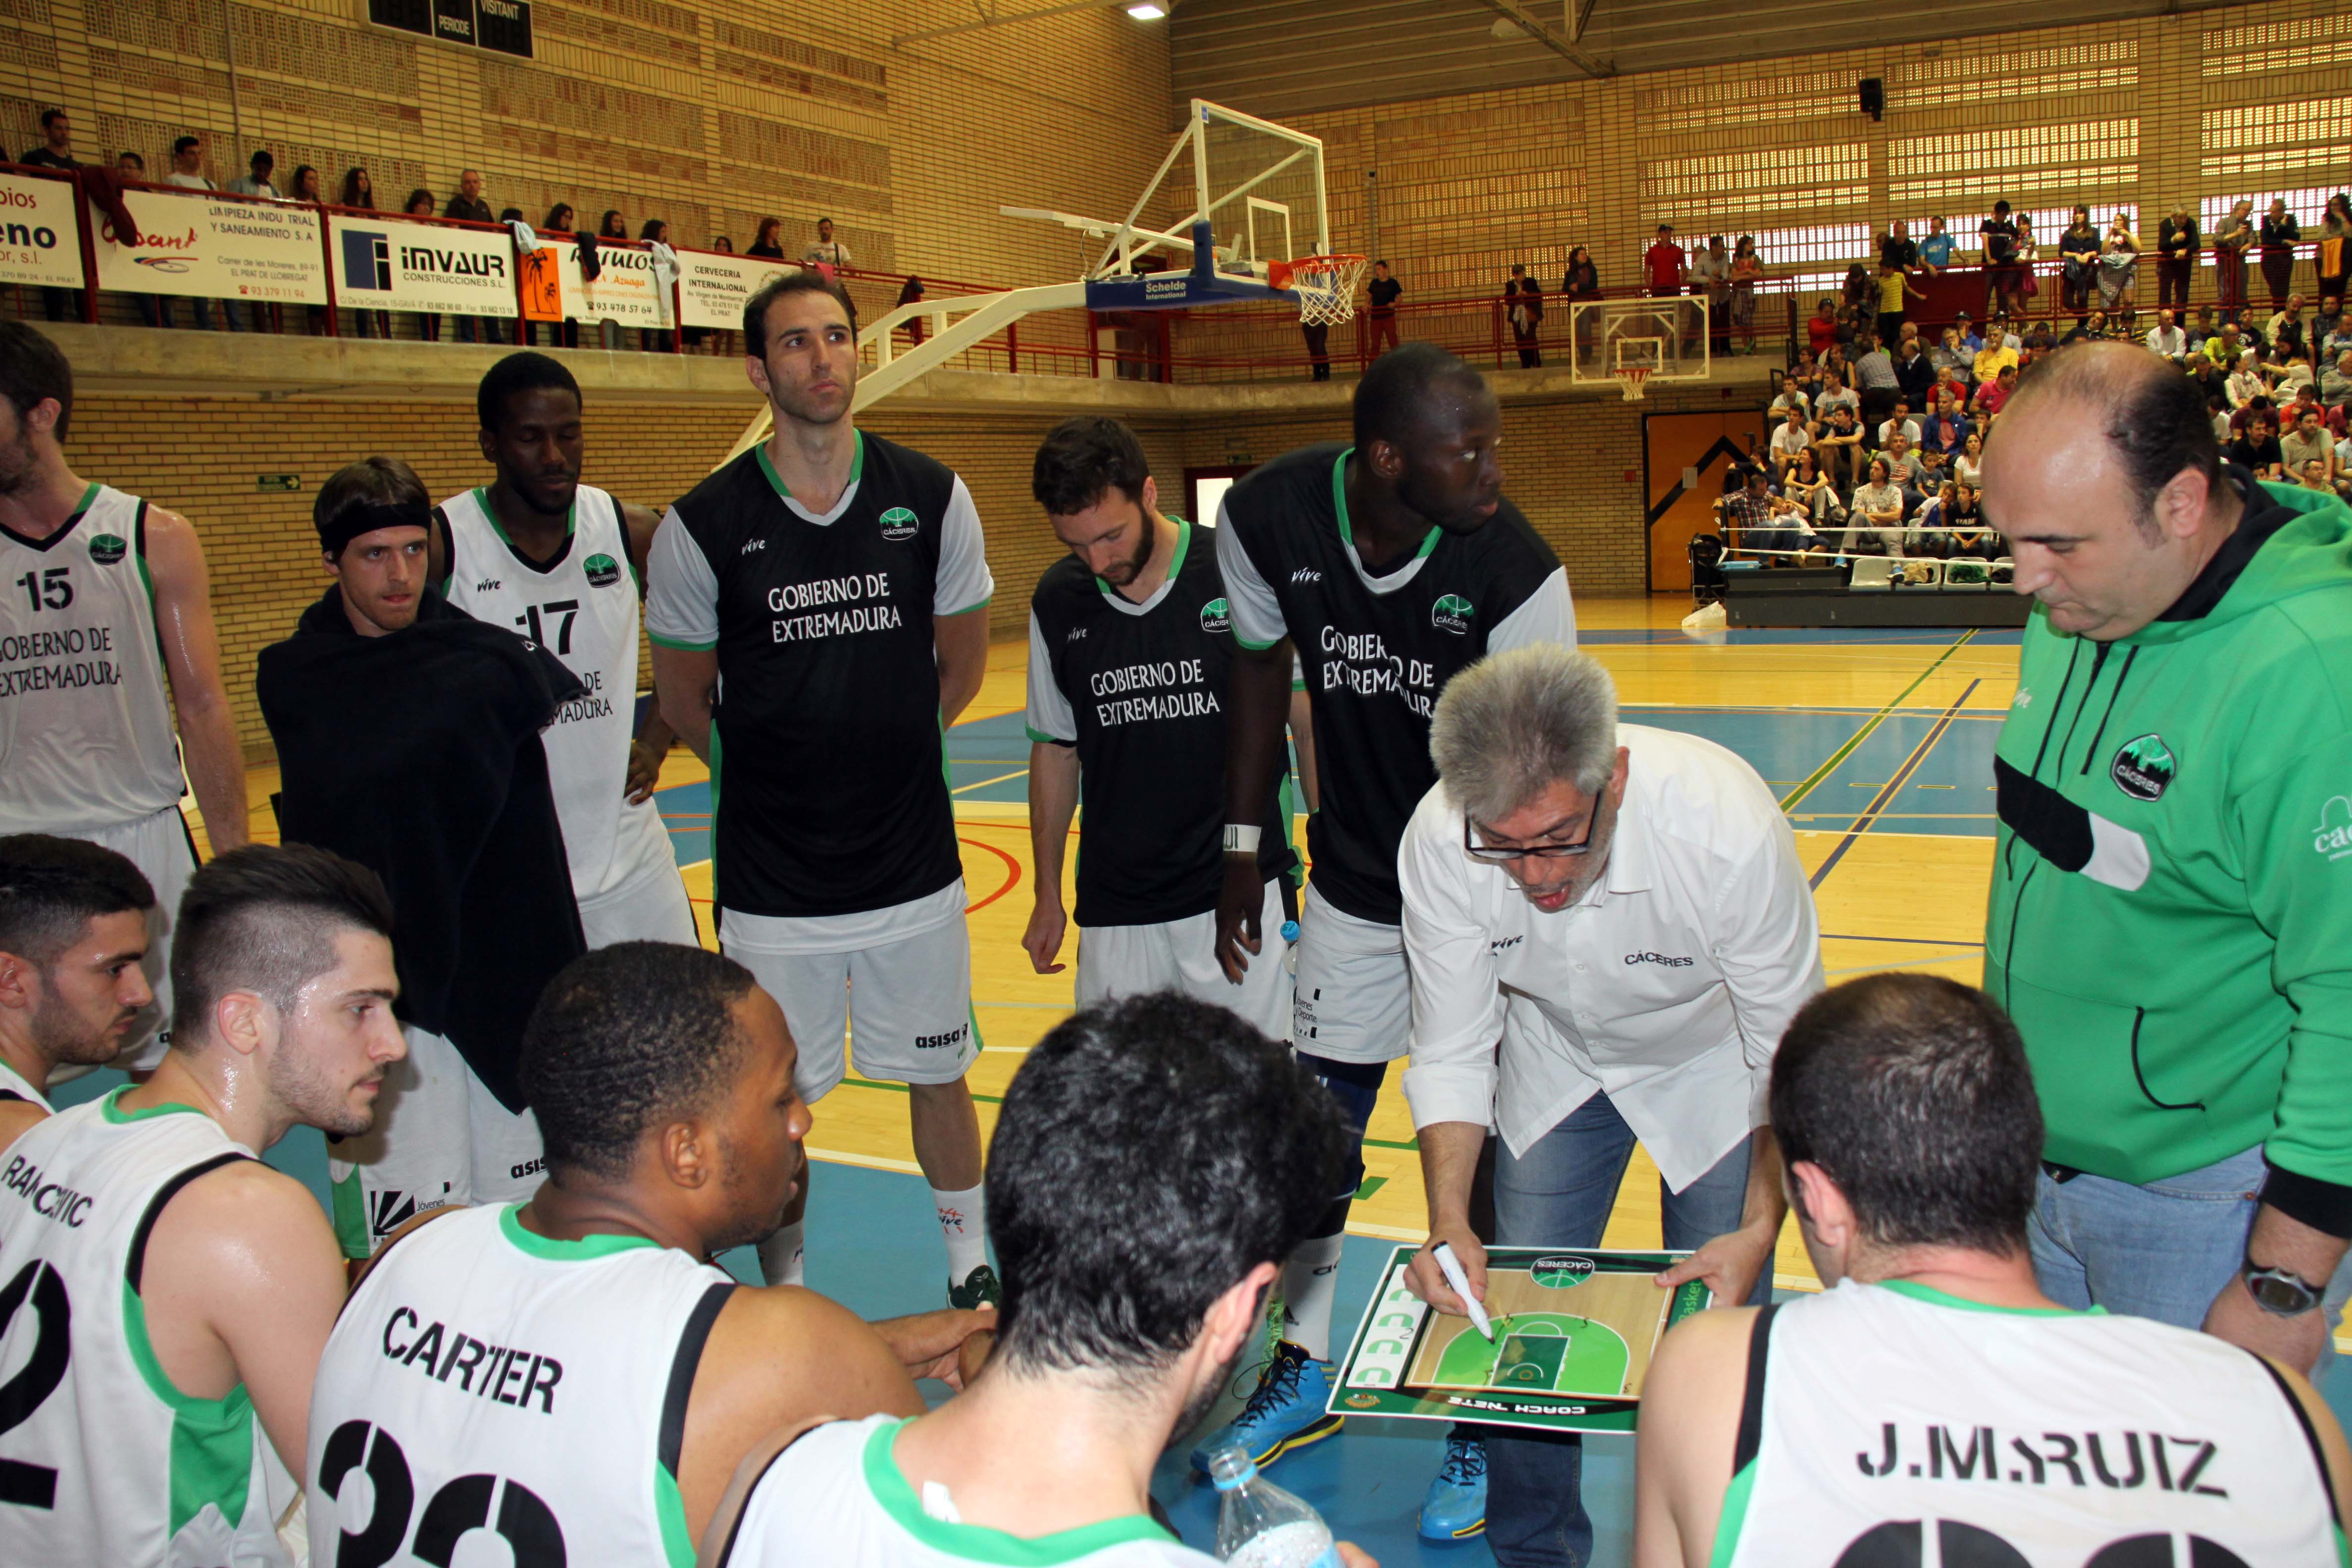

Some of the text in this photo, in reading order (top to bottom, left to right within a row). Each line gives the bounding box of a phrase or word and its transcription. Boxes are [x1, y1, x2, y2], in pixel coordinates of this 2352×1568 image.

[480, 0, 519, 19] VISITANT
[438, 15, 470, 35] PERIODE
[0, 223, 57, 249] no
[210, 222, 217, 232] Y
[220, 222, 291, 239] SANEAMIENTO
[230, 268, 239, 277] EL
[270, 272, 308, 282] LLOBREGAT
[403, 273, 506, 288] CONSTRUCCIONES S.L.
[694, 265, 741, 278] CERVECERIA
[251, 286, 261, 295] 93
[283, 289, 291, 297] 11
[1146, 280, 1186, 293] Schelde
[1146, 291, 1186, 300] International
[596, 302, 652, 314] 93 478 57 64
[883, 525, 916, 535] CÁCERES
[17, 567, 74, 611] 15
[768, 573, 890, 613] GOBIERNO DE
[515, 599, 580, 655] 17
[772, 605, 902, 643] EXTREMADURA
[88, 627, 112, 652] DE
[1091, 659, 1204, 697] GOBIERNO DE
[1409, 659, 1435, 687] DE
[1097, 691, 1221, 727] EXTREMADURA
[2116, 763, 2162, 796] CÁCERES
[1624, 950, 1694, 967] CÁCERES
[915, 1029, 960, 1048] asisa
[511, 1158, 547, 1179] asis
[416, 1198, 445, 1212] Jóvenes
[1537, 1260, 1592, 1270] CÁCERES
[383, 1306, 563, 1414] CARTER
[1514, 1404, 1586, 1415] COACH
